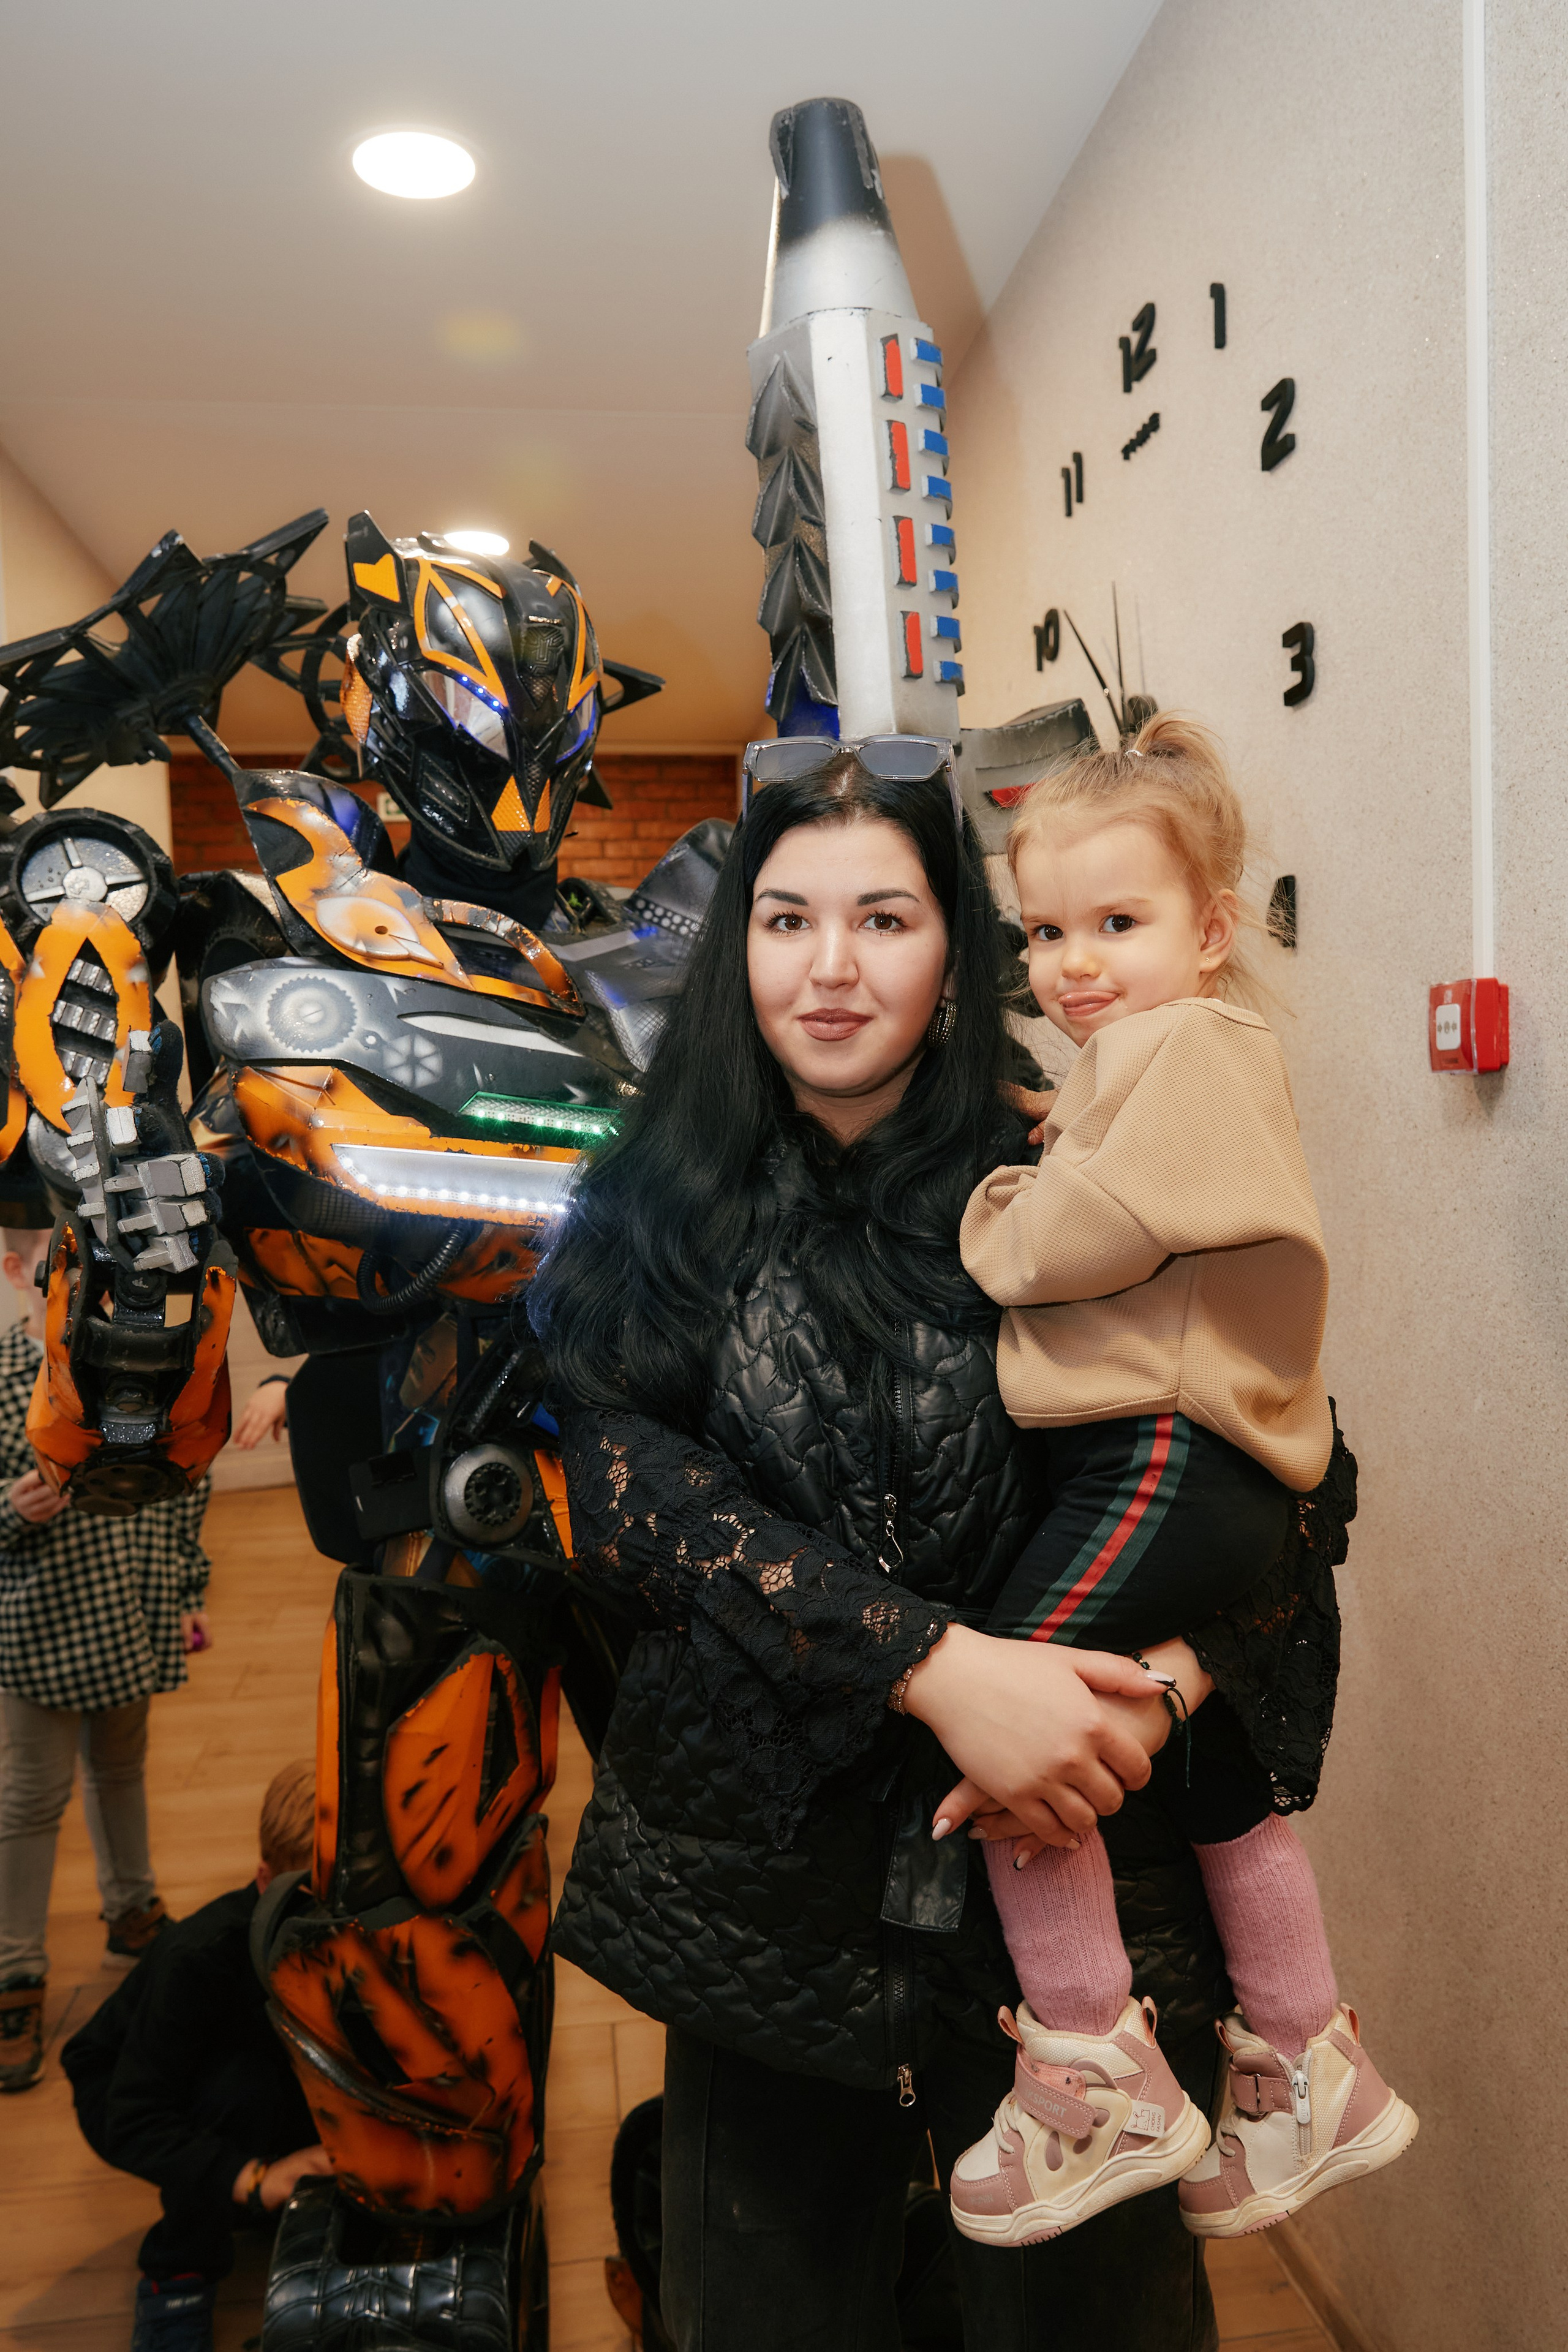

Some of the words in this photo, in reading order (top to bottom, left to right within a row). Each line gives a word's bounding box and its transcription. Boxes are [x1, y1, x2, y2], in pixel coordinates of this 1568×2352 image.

[1118, 303, 1157, 393] 12
[1210, 282, 1227, 350] 1
[1261, 377, 1296, 472] 2
[1061, 451, 1084, 518] 11
[1033, 608, 1060, 672] 10
[1282, 622, 1316, 707] 3
